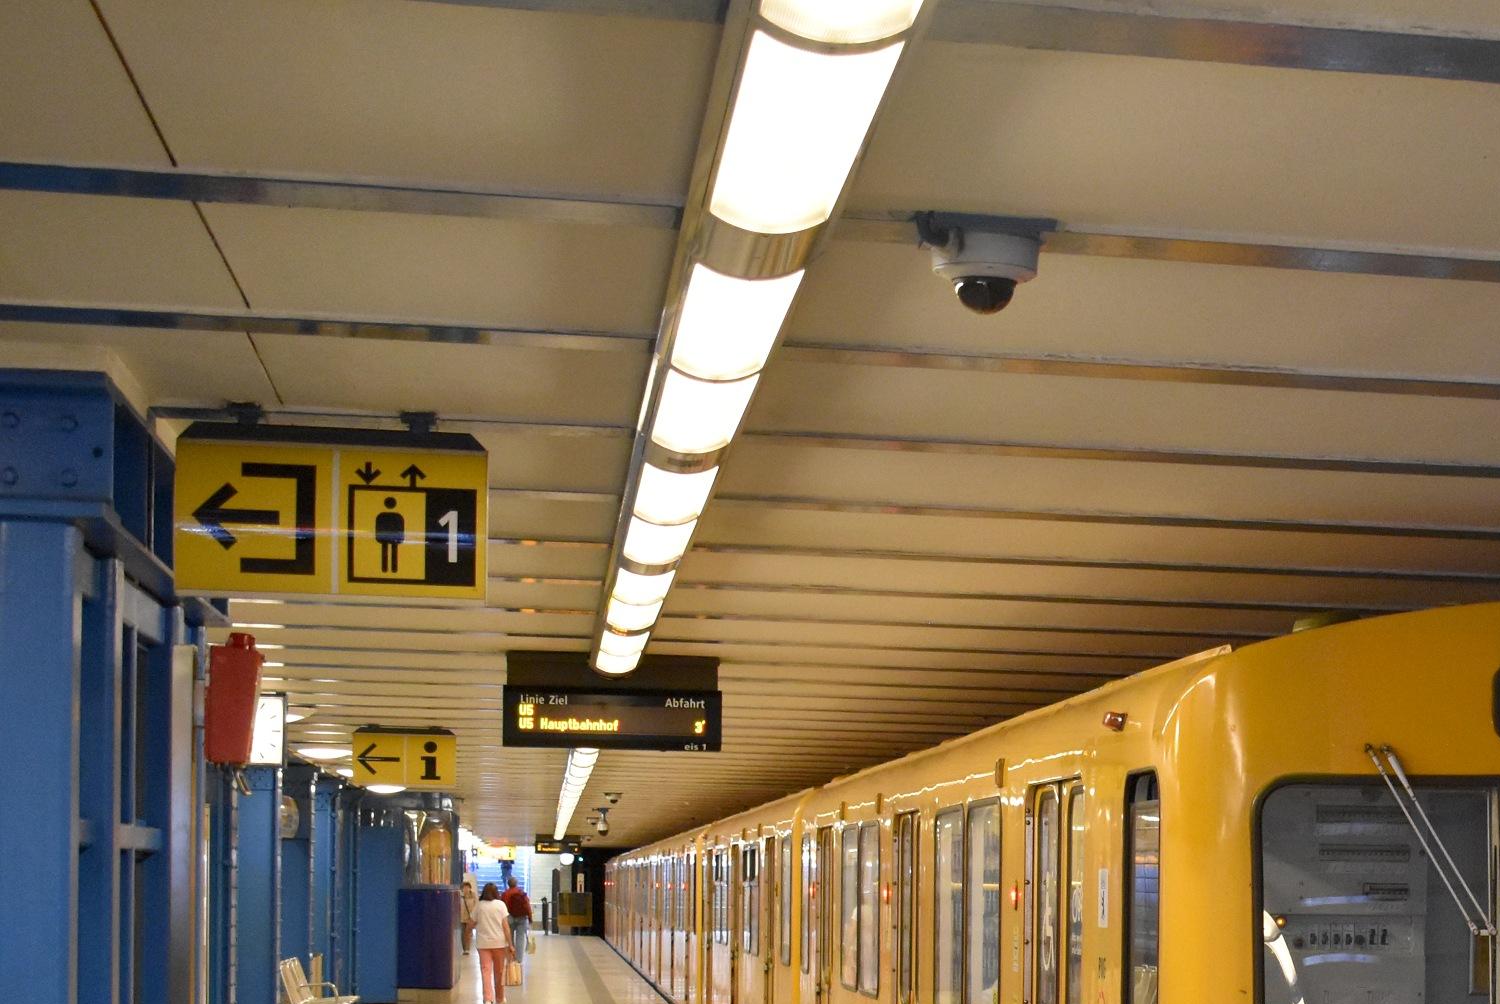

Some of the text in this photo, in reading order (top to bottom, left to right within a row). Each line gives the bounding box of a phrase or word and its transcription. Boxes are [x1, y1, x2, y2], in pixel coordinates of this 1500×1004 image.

[438, 510, 459, 563] 1
[520, 694, 705, 709] Linie Ziel Abfahrt
[519, 717, 534, 730] U5
[540, 717, 619, 732] Hauptbahnhof
